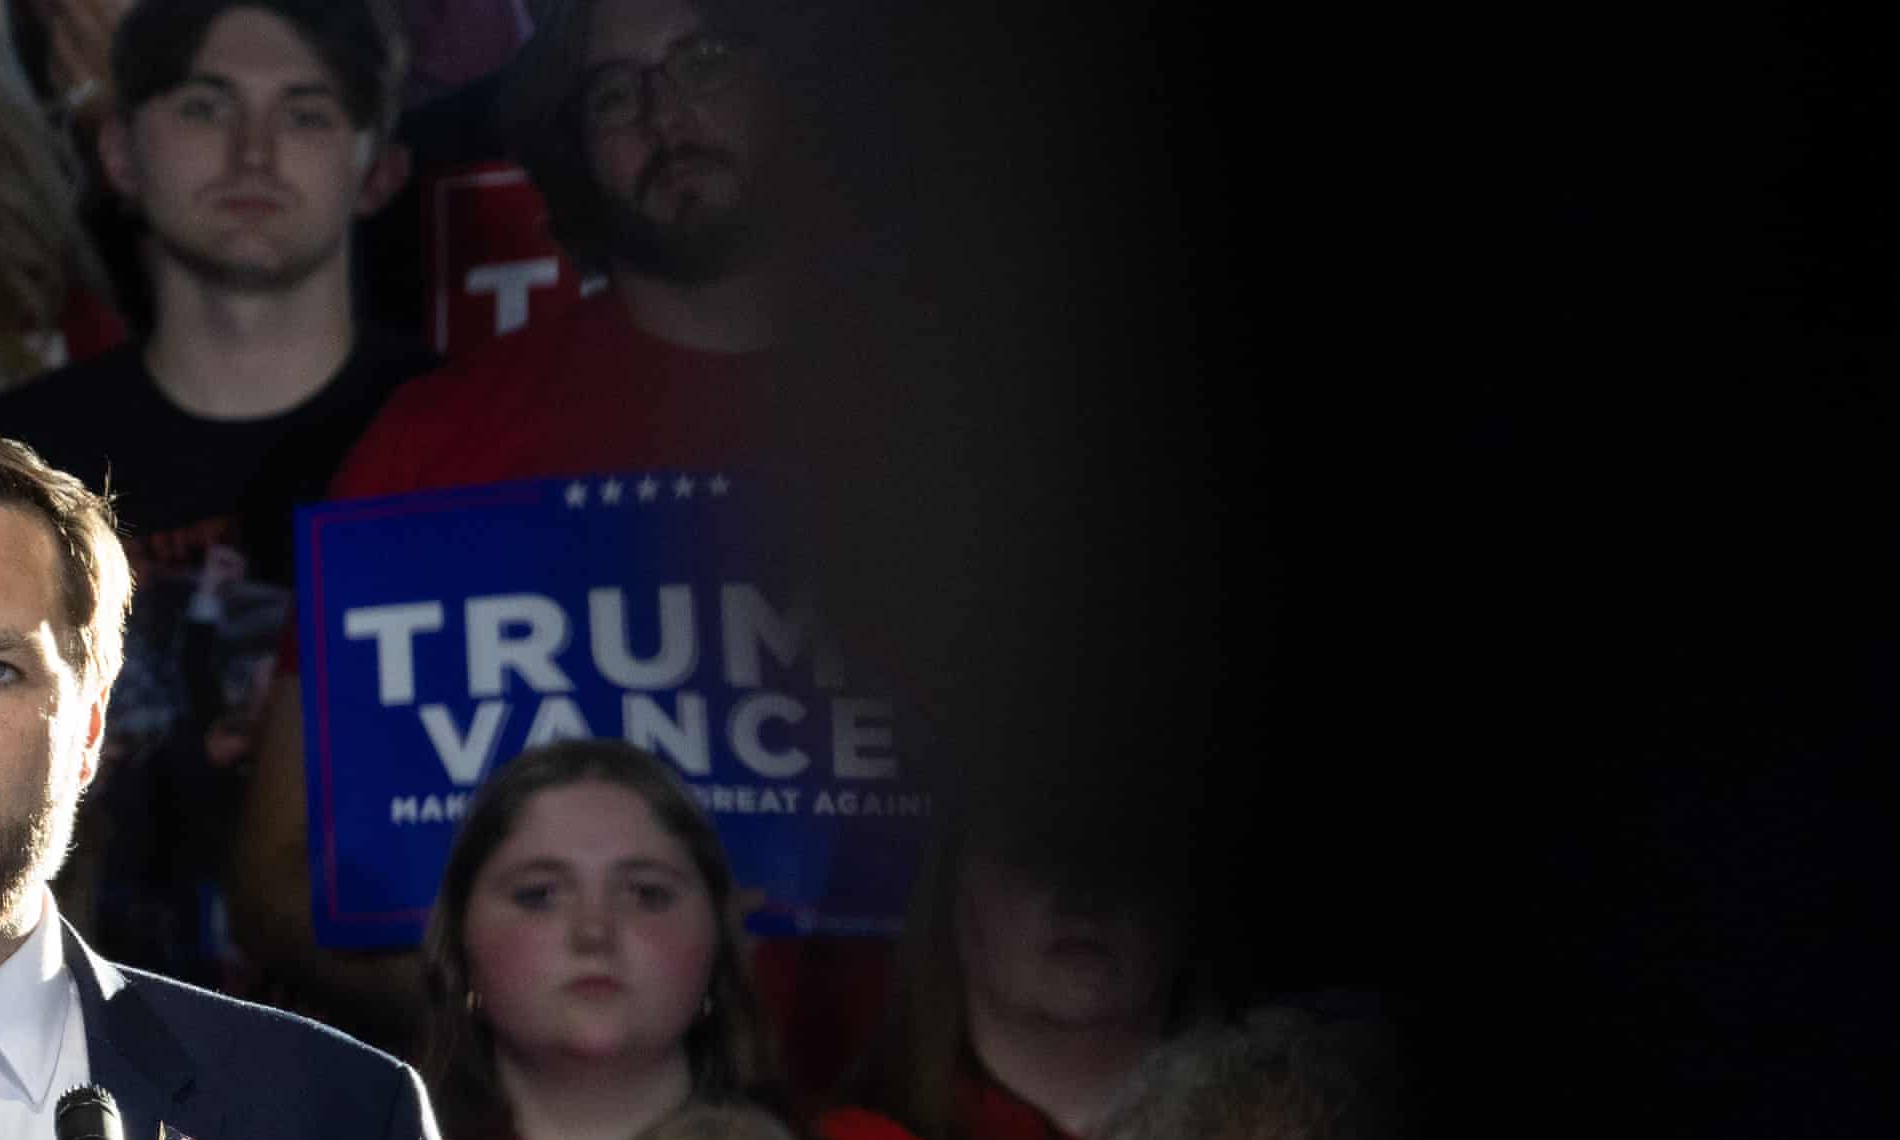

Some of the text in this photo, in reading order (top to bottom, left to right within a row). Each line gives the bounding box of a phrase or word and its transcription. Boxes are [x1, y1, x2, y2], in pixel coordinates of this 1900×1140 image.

[343, 584, 844, 706] TRUM
[390, 793, 470, 826] MAK
[698, 784, 800, 816] REAT
